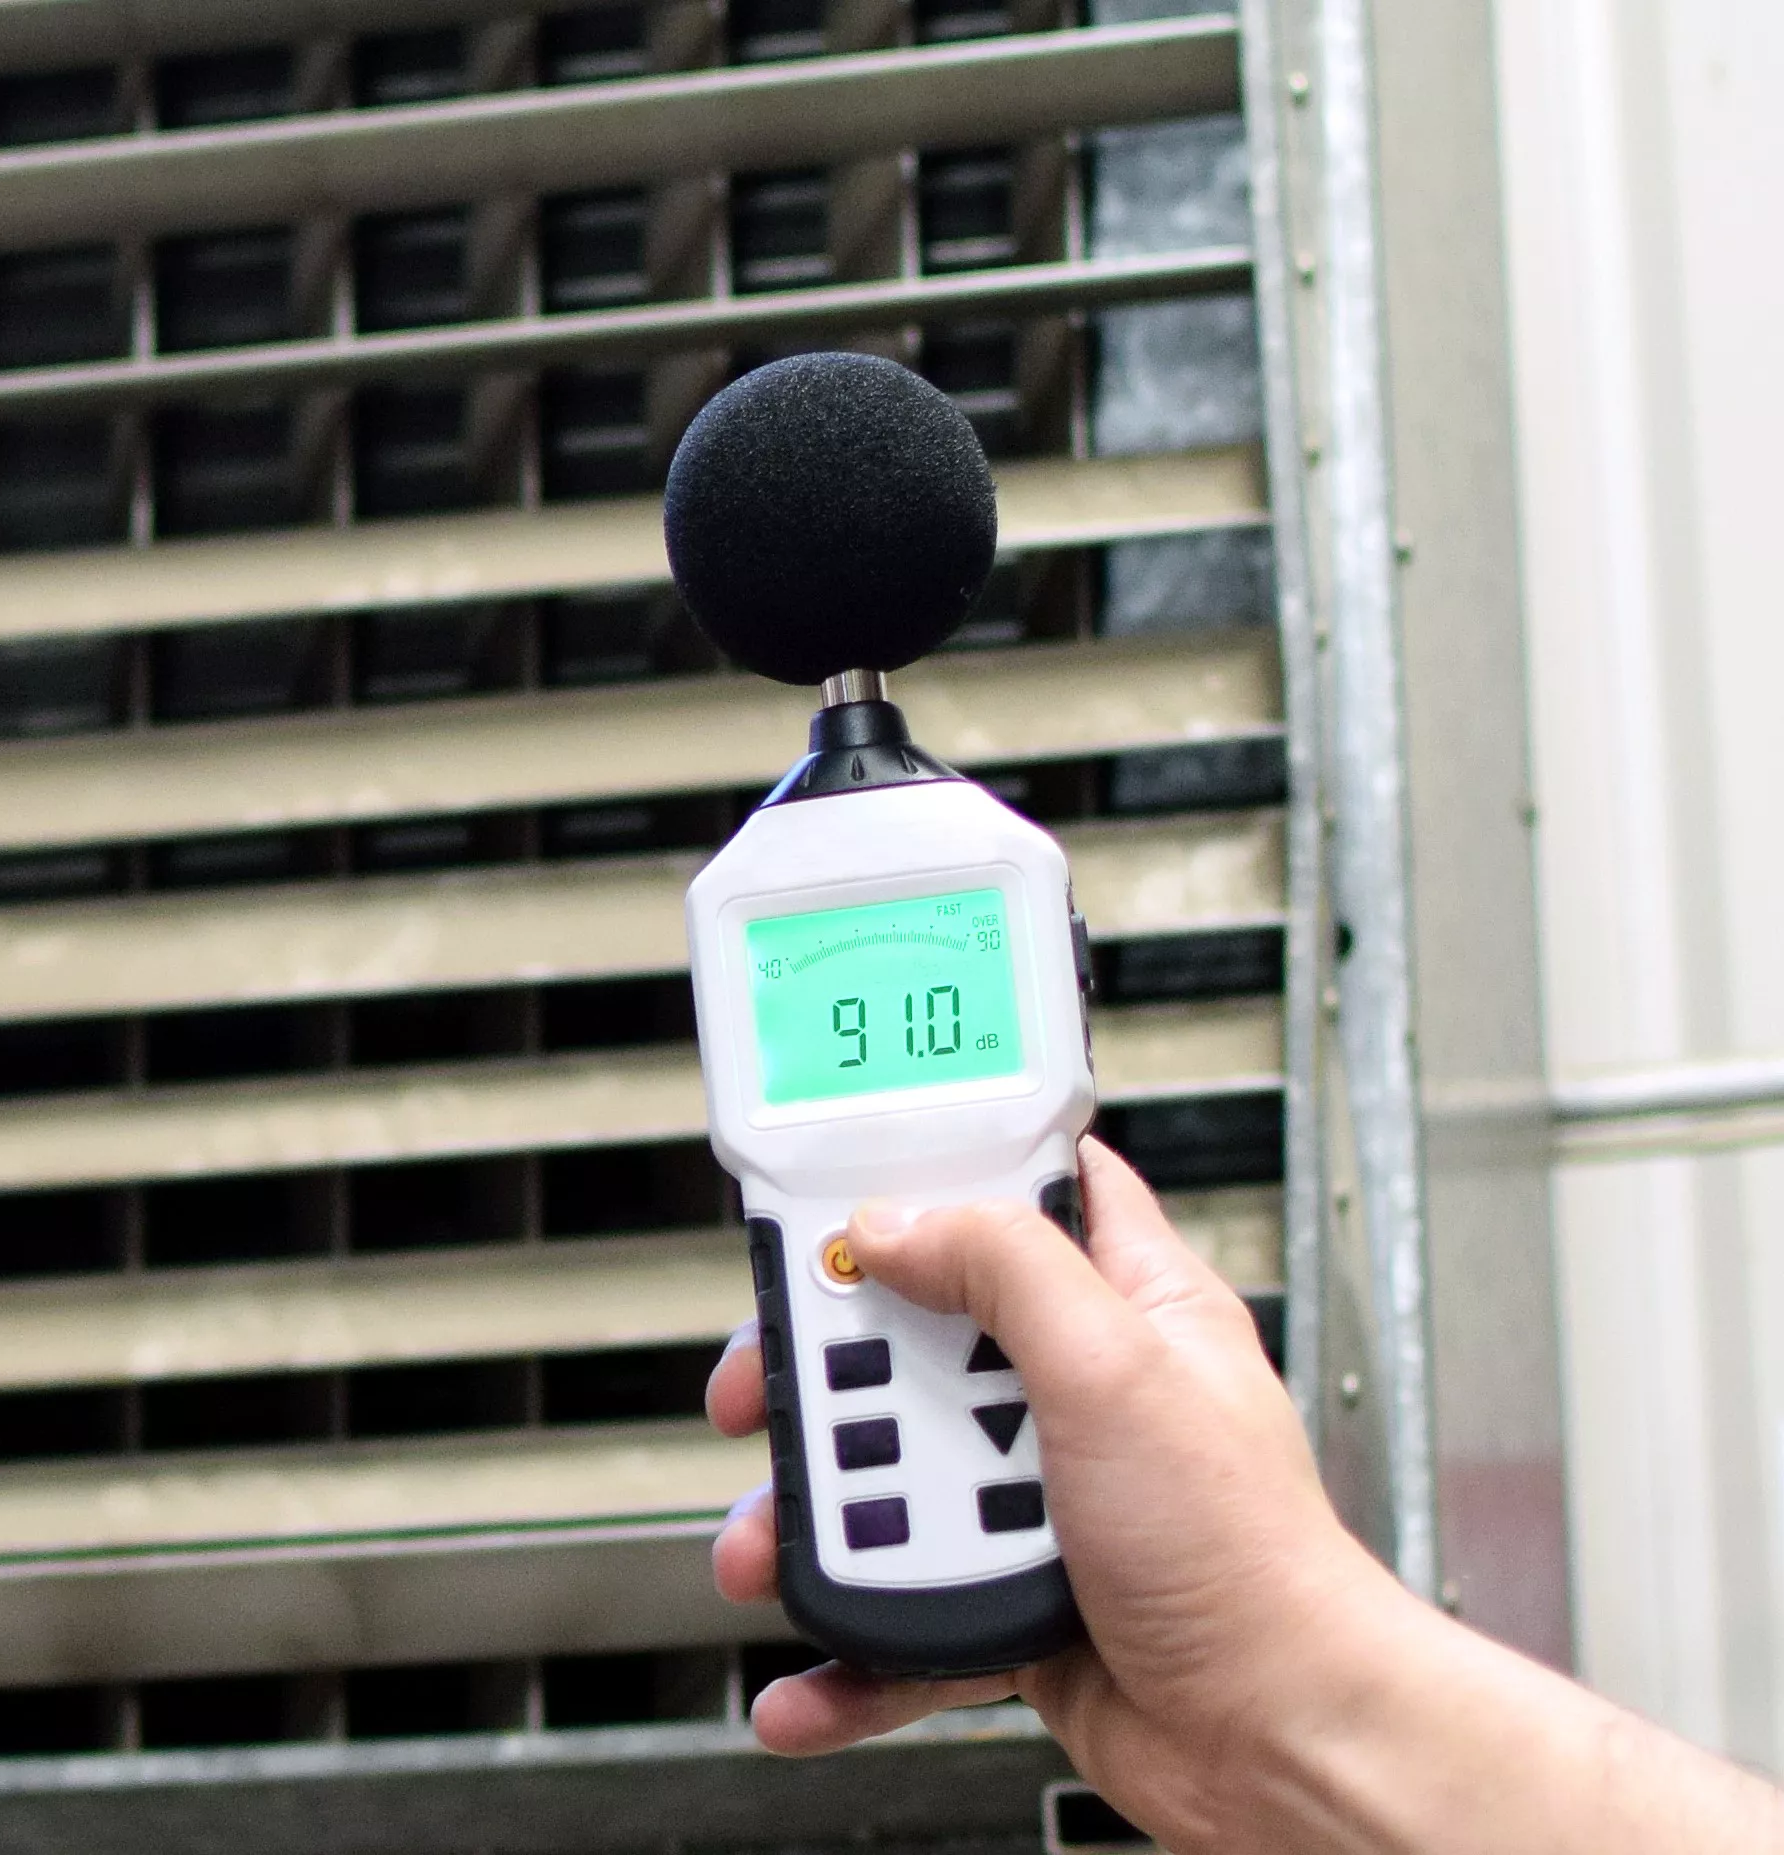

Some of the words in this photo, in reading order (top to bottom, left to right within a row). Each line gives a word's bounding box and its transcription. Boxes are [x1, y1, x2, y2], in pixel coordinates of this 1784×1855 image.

[936, 903, 962, 916] FAST
[972, 914, 998, 928] OVER
[977, 930, 1000, 952] 90
[758, 959, 781, 979] 40
[832, 985, 960, 1068] 91.0
[976, 1033, 999, 1050] dB
